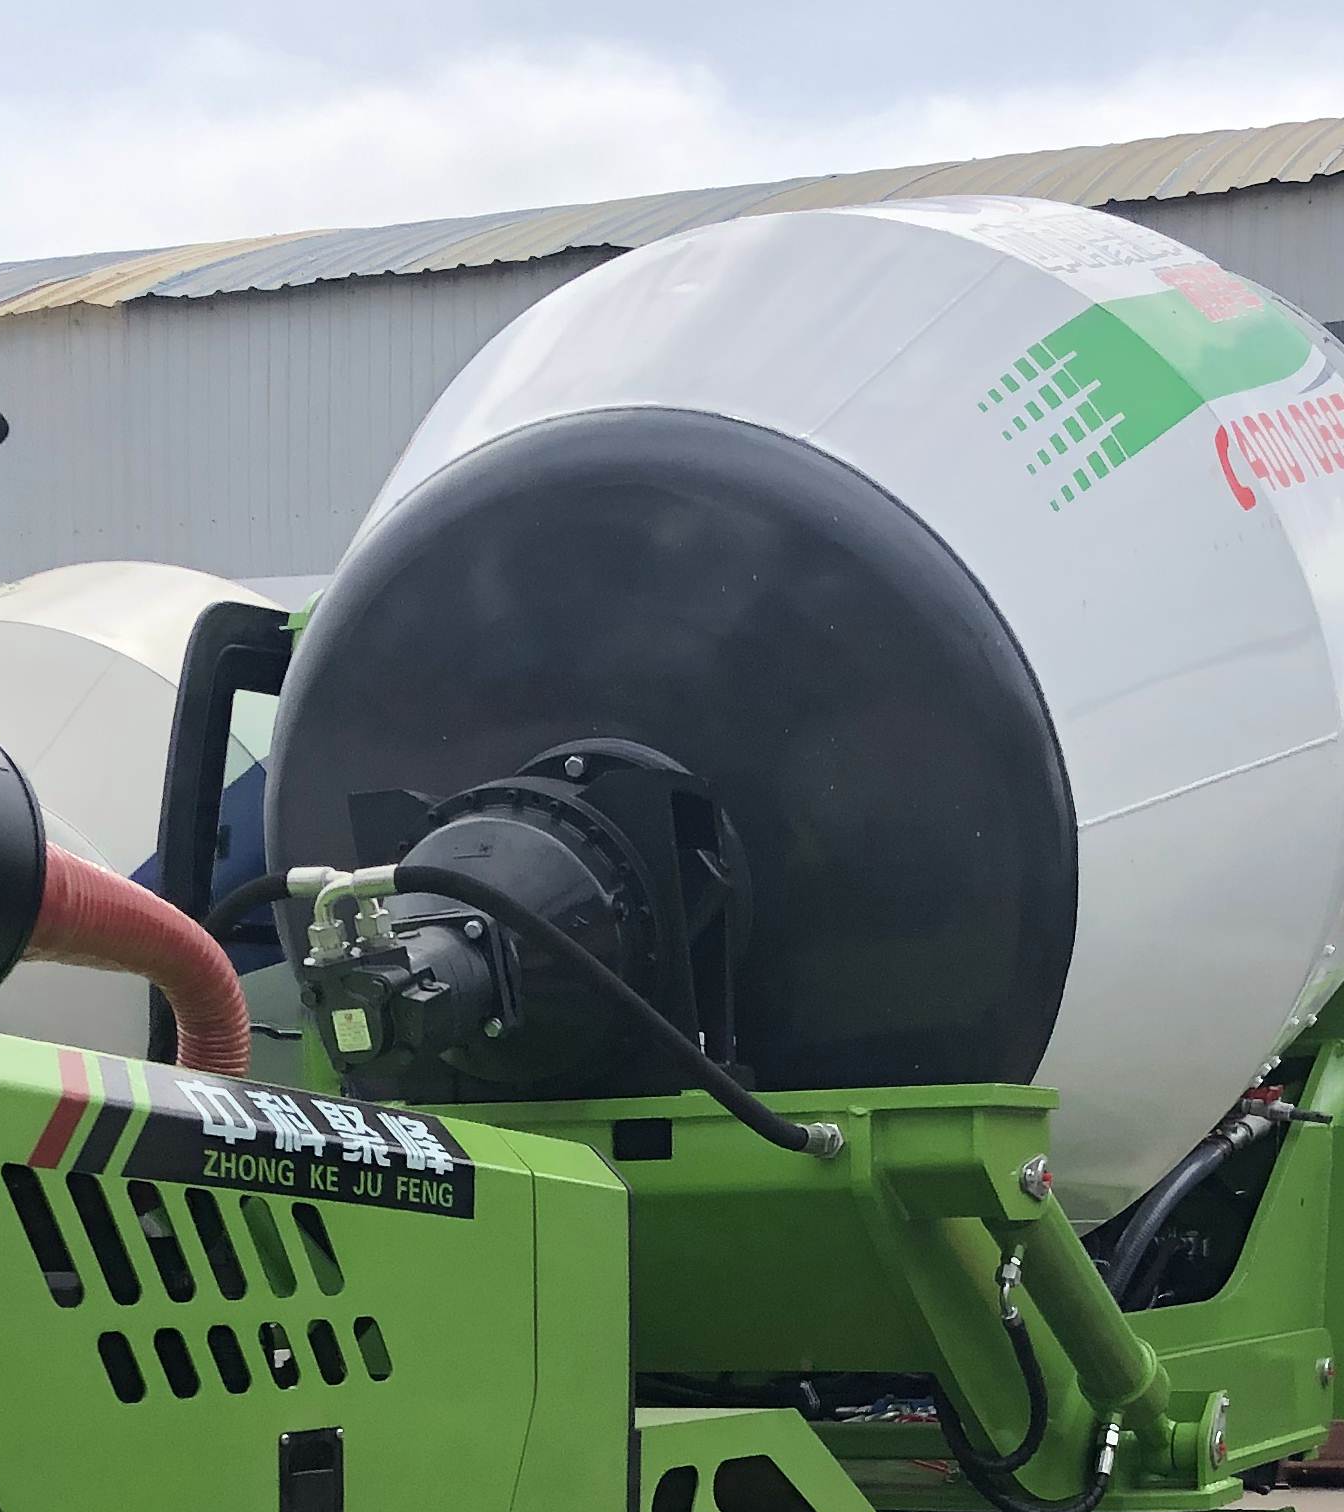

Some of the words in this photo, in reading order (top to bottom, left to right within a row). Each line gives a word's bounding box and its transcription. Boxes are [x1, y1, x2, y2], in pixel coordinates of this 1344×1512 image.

[175, 1080, 454, 1175] 中科聚峰
[203, 1149, 295, 1187] ZHONG
[310, 1163, 339, 1192] KE
[353, 1171, 383, 1197] JU
[396, 1176, 454, 1208] FENG
